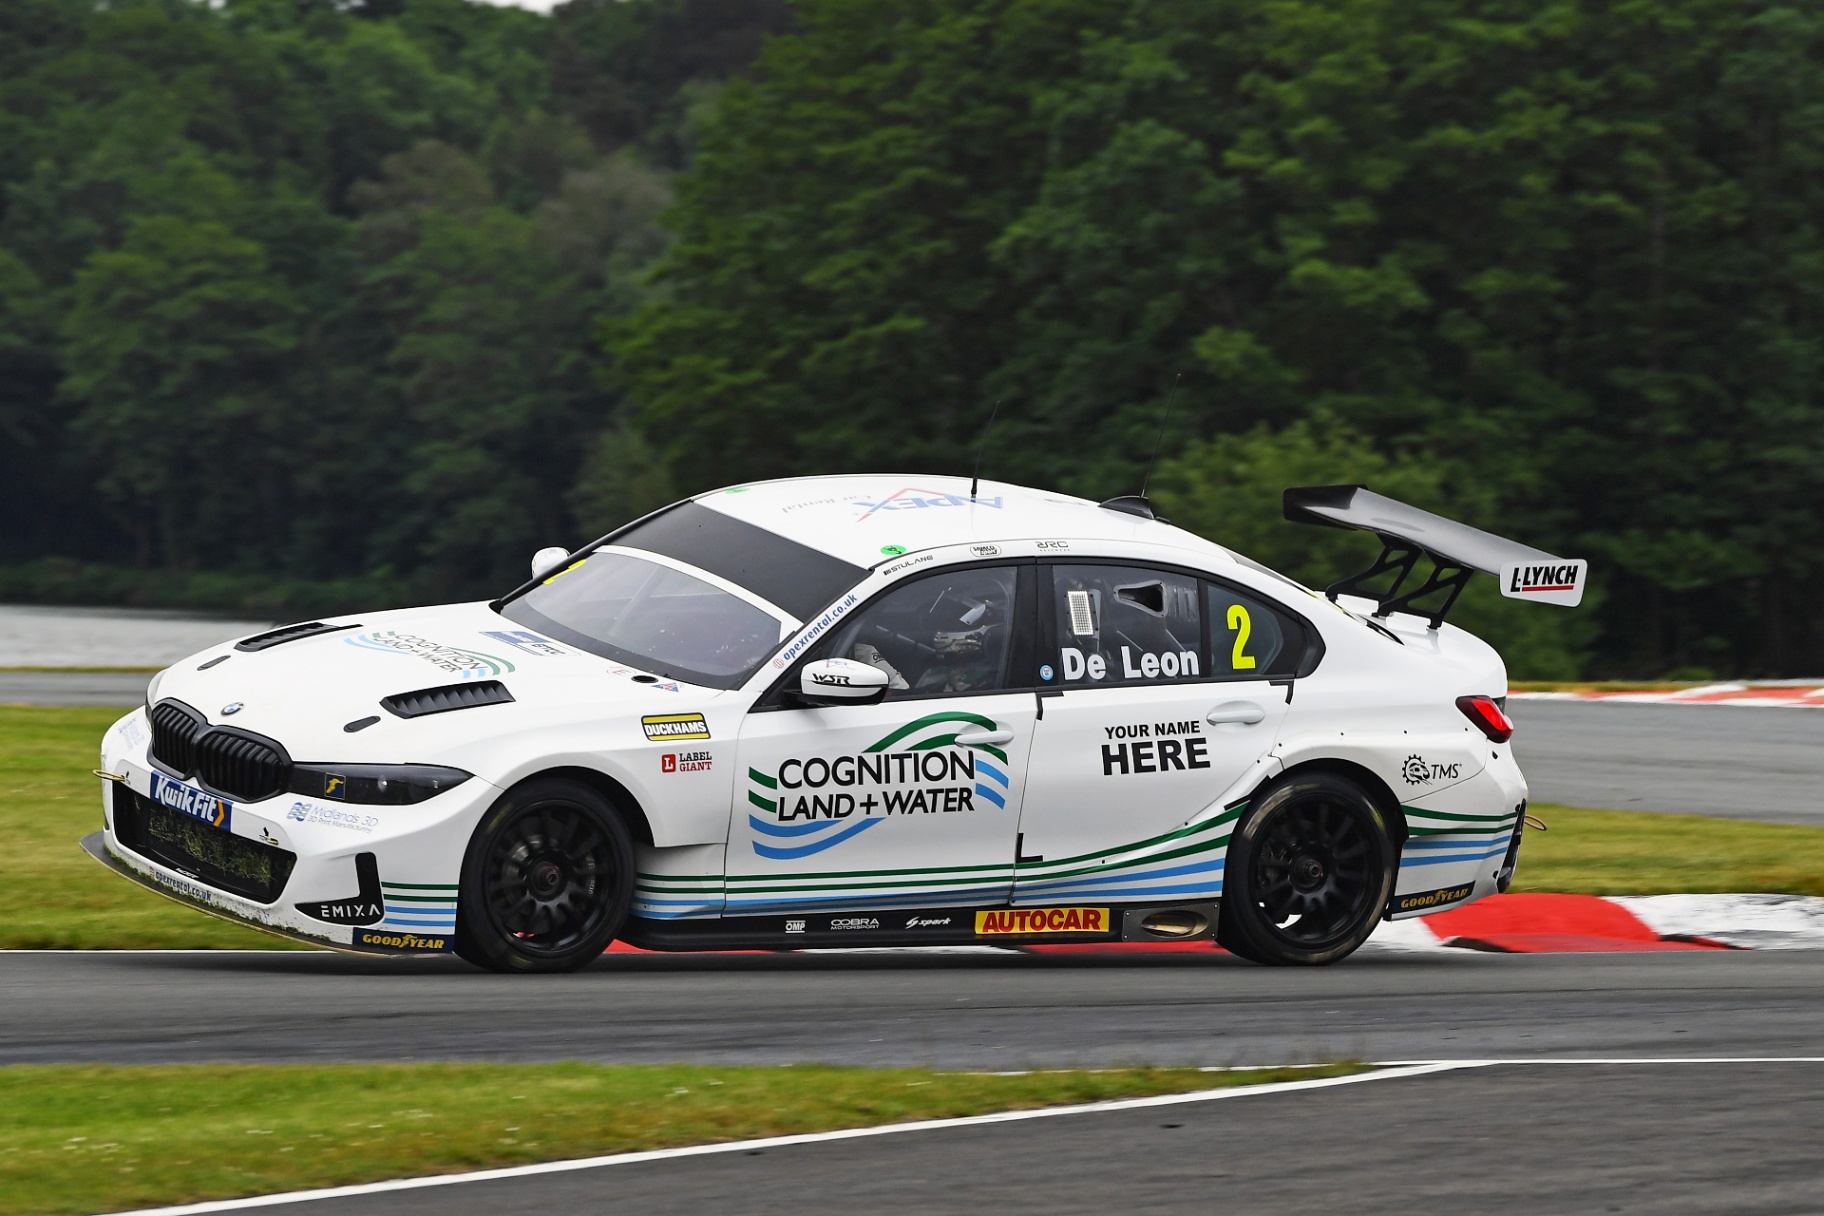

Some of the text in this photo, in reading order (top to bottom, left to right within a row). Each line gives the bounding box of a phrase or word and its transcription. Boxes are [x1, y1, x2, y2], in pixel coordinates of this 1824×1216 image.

[784, 593, 857, 661] apexrental.co.uk
[1226, 604, 1256, 670] 2
[1061, 646, 1199, 680] De Leon
[812, 673, 850, 686] WSR
[644, 721, 706, 736] DUCKHAMS
[1104, 720, 1200, 739] YOUR NAME
[679, 751, 712, 762] LABEL
[1101, 737, 1211, 776] HERE
[679, 761, 712, 772] GIANT
[778, 750, 975, 789] COGNITION
[1430, 763, 1460, 780] TMS
[778, 793, 856, 822] LAND
[882, 787, 975, 816] WATER
[361, 815, 379, 828] 3D
[1401, 888, 1469, 908] GOODYEAR
[321, 904, 381, 918] EMIXA
[785, 922, 805, 931] OMP
[830, 918, 880, 926] COBRA
[982, 909, 1102, 933] AUTOCAR
[362, 933, 445, 949] GOODYEAR
